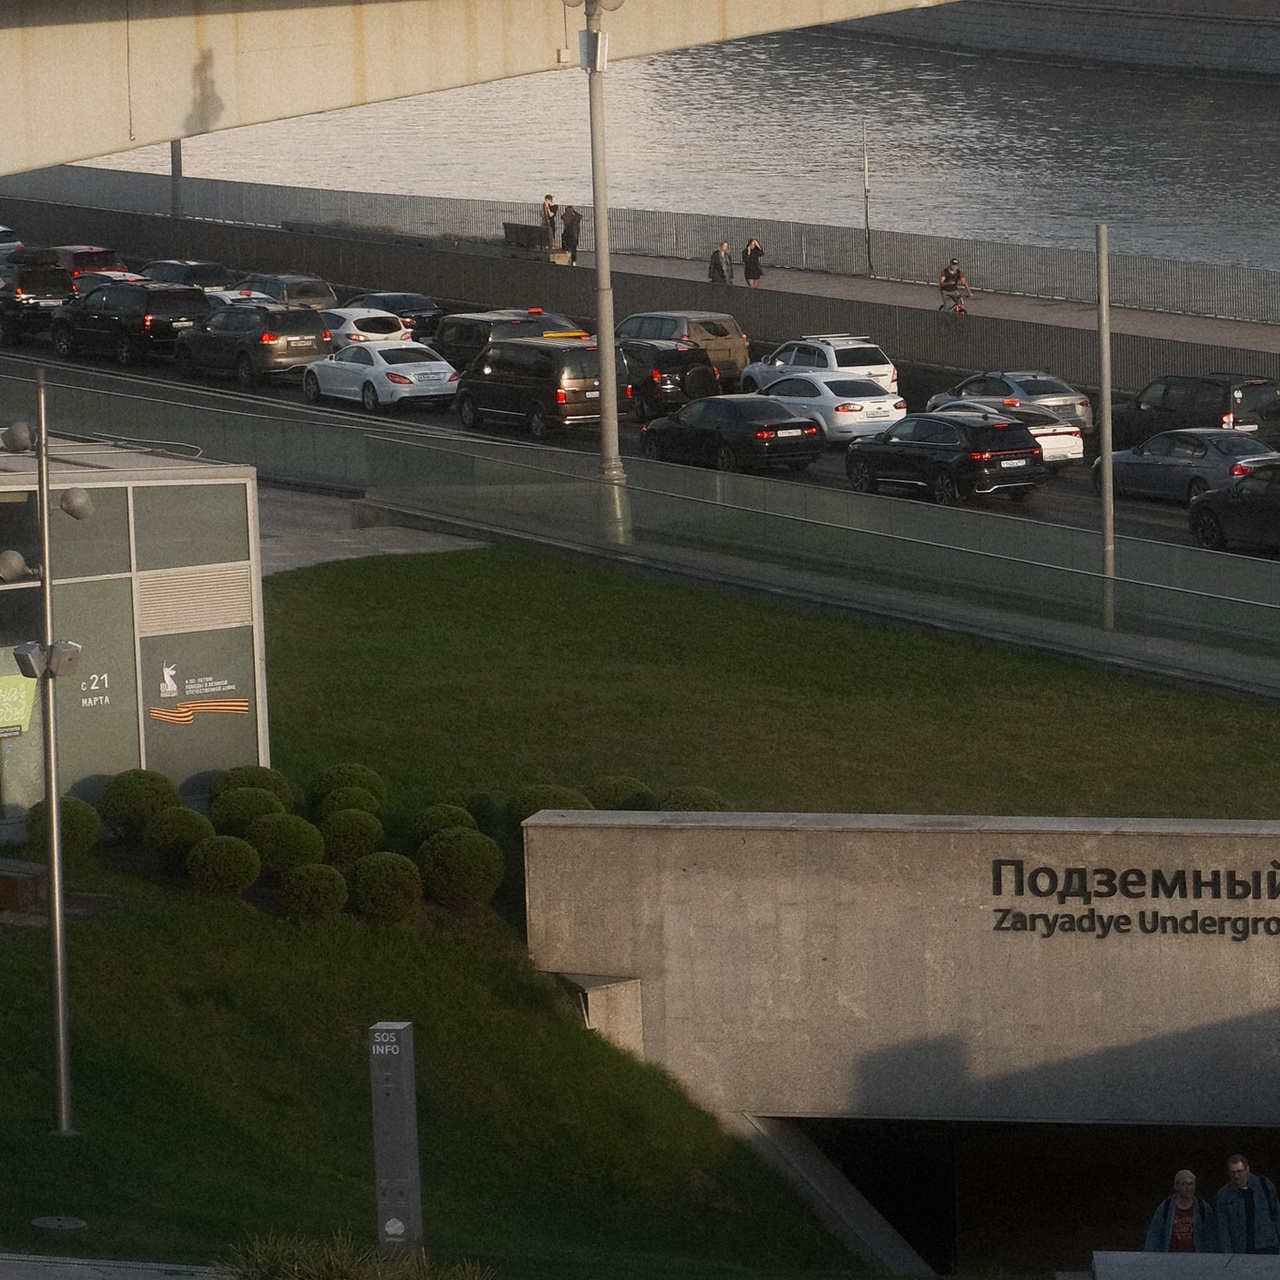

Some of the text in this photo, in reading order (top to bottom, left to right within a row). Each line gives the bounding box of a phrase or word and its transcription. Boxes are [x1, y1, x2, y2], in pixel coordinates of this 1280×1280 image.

[90, 673, 109, 690] 21
[81, 695, 111, 707] МАРТА
[992, 907, 1132, 940] Zaryadye
[374, 1032, 397, 1043] SOS
[372, 1044, 400, 1055] INFO
